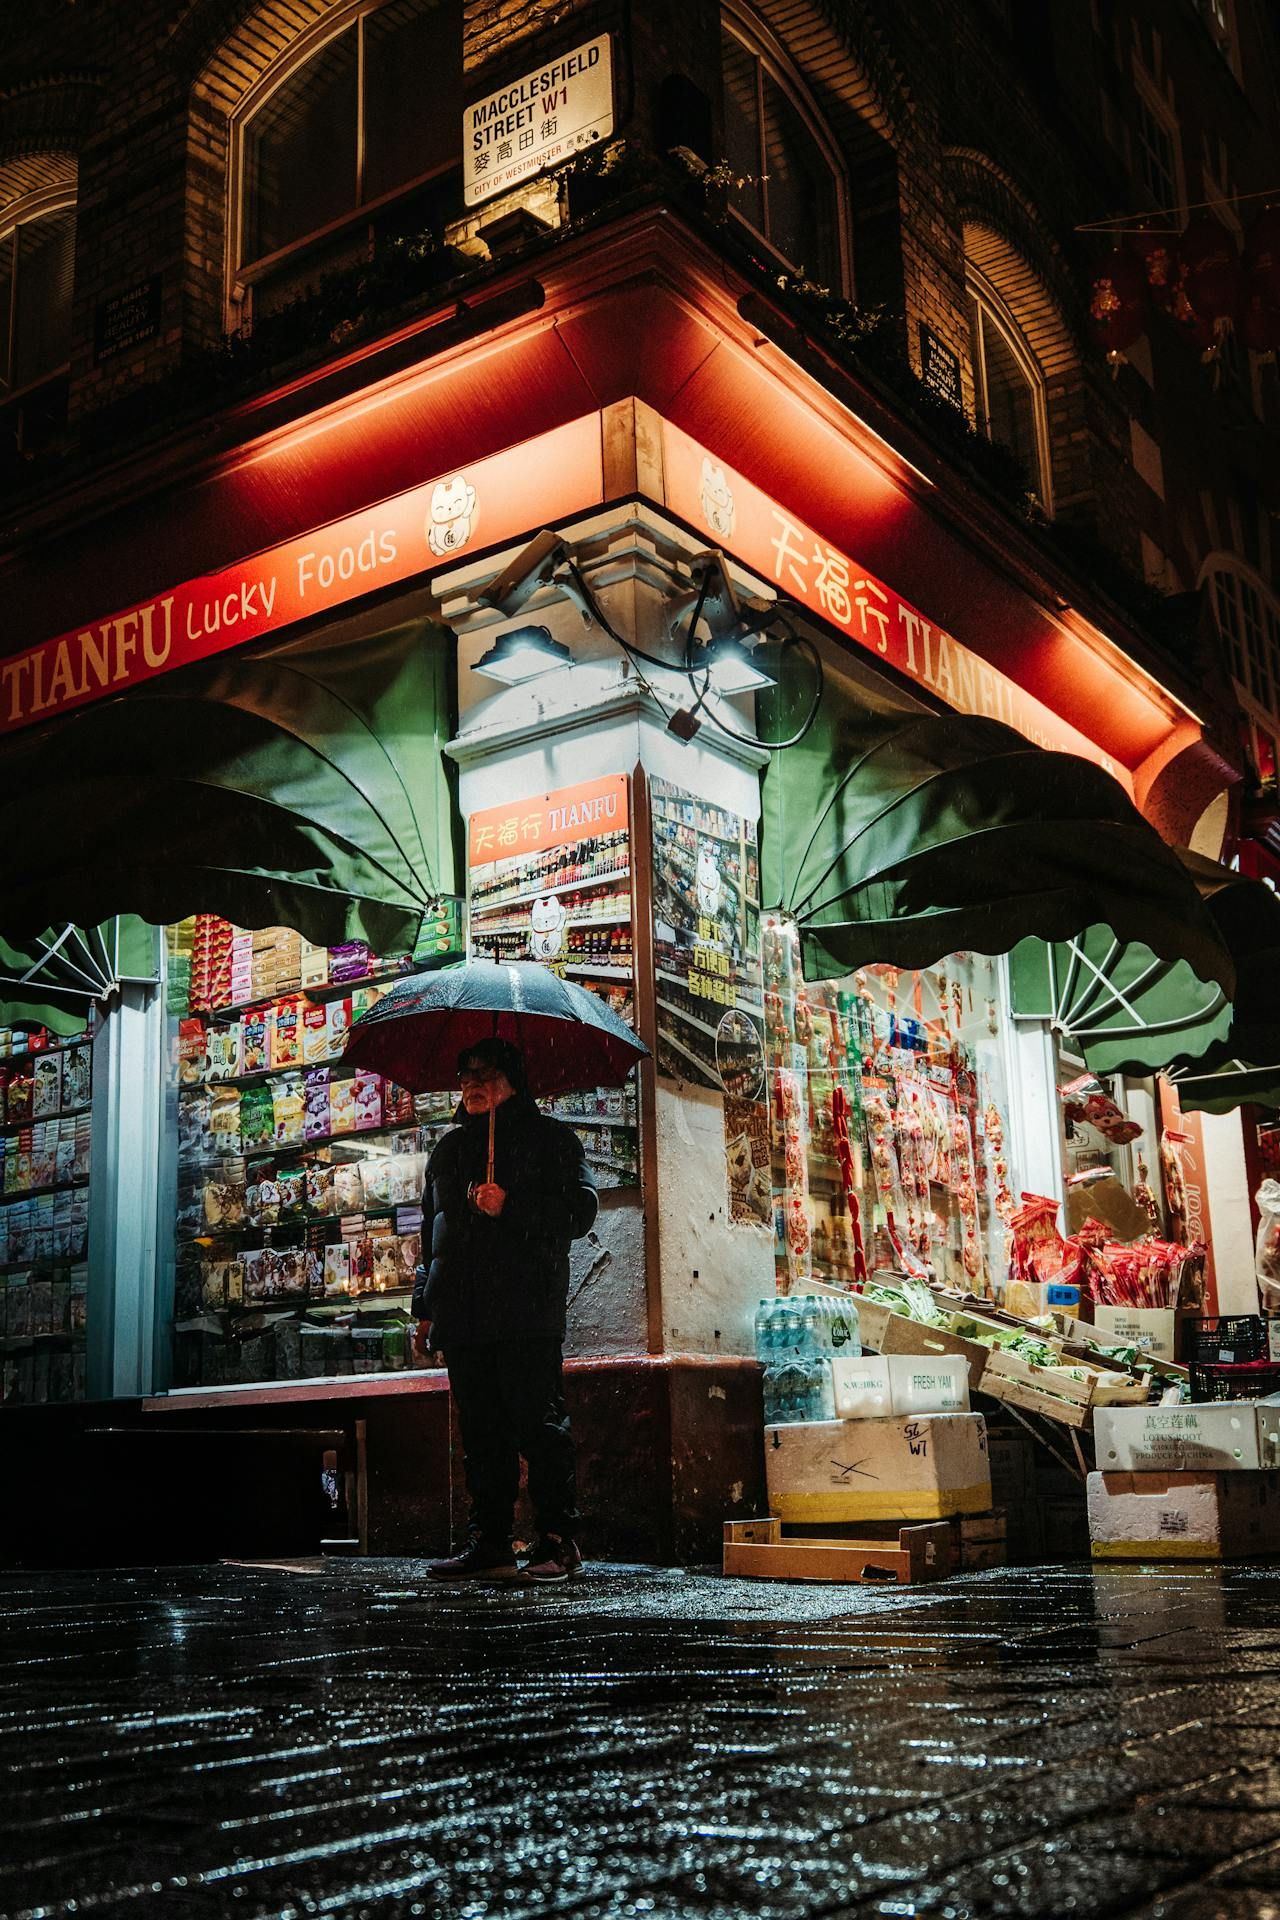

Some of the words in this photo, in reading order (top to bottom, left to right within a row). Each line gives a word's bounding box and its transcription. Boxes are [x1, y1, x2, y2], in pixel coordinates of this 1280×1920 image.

[473, 46, 600, 128] MACCLESFIELD
[473, 103, 536, 150] STREET
[542, 86, 567, 115] W1
[474, 180, 491, 196] CITY
[493, 173, 503, 186] OF
[505, 144, 562, 179] WESTMINSTER
[186, 576, 277, 640] Lucky
[297, 528, 397, 597] Foods
[770, 510, 889, 654] 天福行
[2, 596, 175, 723] TIANFU
[898, 603, 1016, 728] TIANFU
[475, 813, 543, 855] 天福行
[549, 793, 618, 832] TIANFU
[913, 1375, 935, 1390] FRESH
[939, 1375, 952, 1389] YAM
[1143, 1432, 1173, 1441] LOTUS
